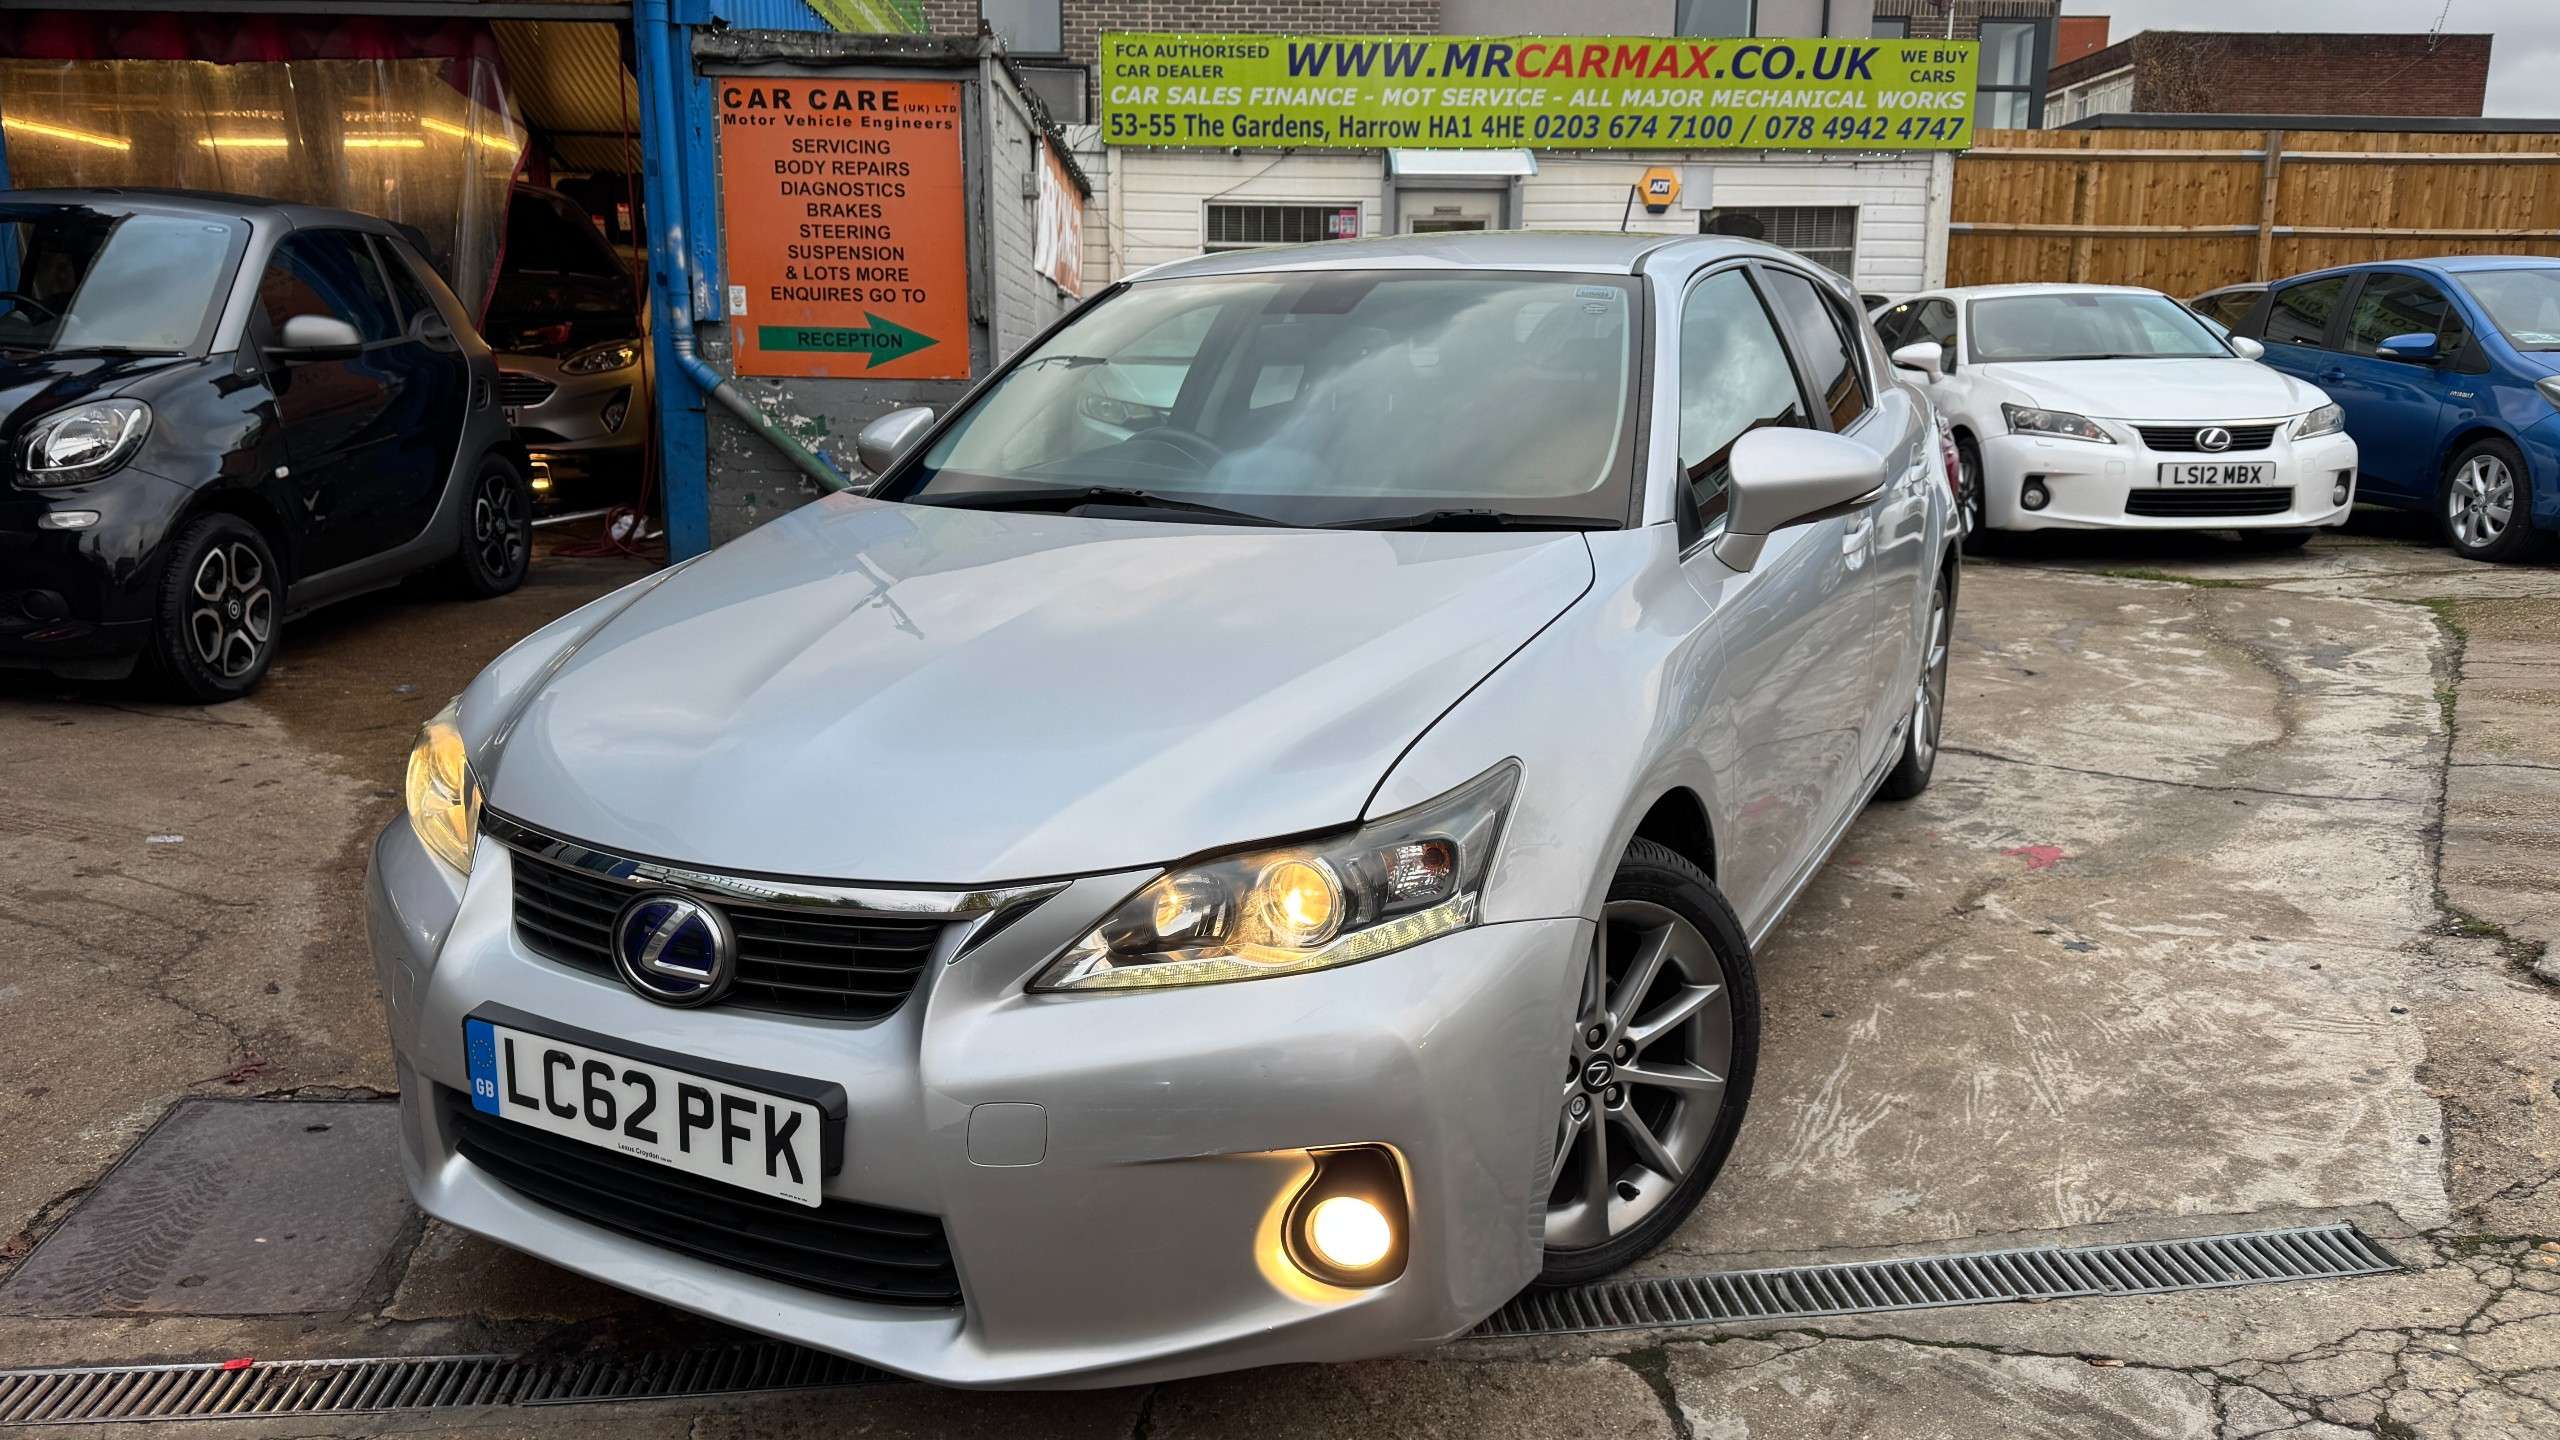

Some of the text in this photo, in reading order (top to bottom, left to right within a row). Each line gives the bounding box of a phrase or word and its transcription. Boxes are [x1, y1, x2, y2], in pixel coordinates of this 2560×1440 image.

[1115, 44, 1270, 59] FCA AUTHORISED
[1901, 50, 1969, 64] WE BUY
[1288, 42, 1880, 80] WWW.MRCARMAX.CO.UK
[1115, 64, 1223, 78] CAR DEALER
[1910, 70, 1956, 83] CARS
[723, 88, 957, 114] CAR CARE (UK) LTD
[1111, 86, 1159, 104] CAR
[1167, 86, 1242, 105] SALES
[1249, 87, 1357, 106] FINANCE
[1381, 88, 1436, 106] MOT
[1440, 88, 1546, 107] SERVICE
[1569, 89, 1611, 107] ALL
[1621, 89, 1704, 107] MAJOR
[1711, 89, 1866, 108] MECHANICAL
[1878, 91, 1966, 109] WORKS
[723, 113, 953, 131] Motor Vehicle Engineers
[1111, 112, 1176, 137] 53-55
[1183, 113, 1225, 137] The
[1232, 113, 1330, 142] Gardens,
[1339, 115, 1421, 138] Harrow
[1429, 115, 1473, 138] HA1
[1481, 115, 1525, 138] 4HE
[1534, 114, 1601, 139] 0203
[1609, 115, 1658, 139] 674
[1667, 115, 1733, 139] 7100
[1765, 116, 1815, 140] 078
[1822, 116, 1889, 140] 4942
[1896, 117, 1965, 141] 4747
[792, 138, 891, 155] SERVICING
[774, 159, 910, 177] BODY REPAIRS
[781, 181, 906, 198] DIAGNOSTICS
[1650, 180, 1670, 193] ADT
[806, 202, 882, 219] BRAKES
[799, 223, 891, 240] STEERING
[787, 244, 905, 261] SUSPENSION
[785, 265, 909, 282] & LOTS MORE
[771, 286, 926, 304] ENQUIRES GO TO
[797, 331, 903, 348] RECEPTION
[2173, 465, 2262, 485] LS12 MBX
[475, 1077, 495, 1099] GB
[503, 1037, 804, 1185] LC62 PFK
[617, 1143, 635, 1153] Lexus
[635, 1147, 660, 1160] Croydon
